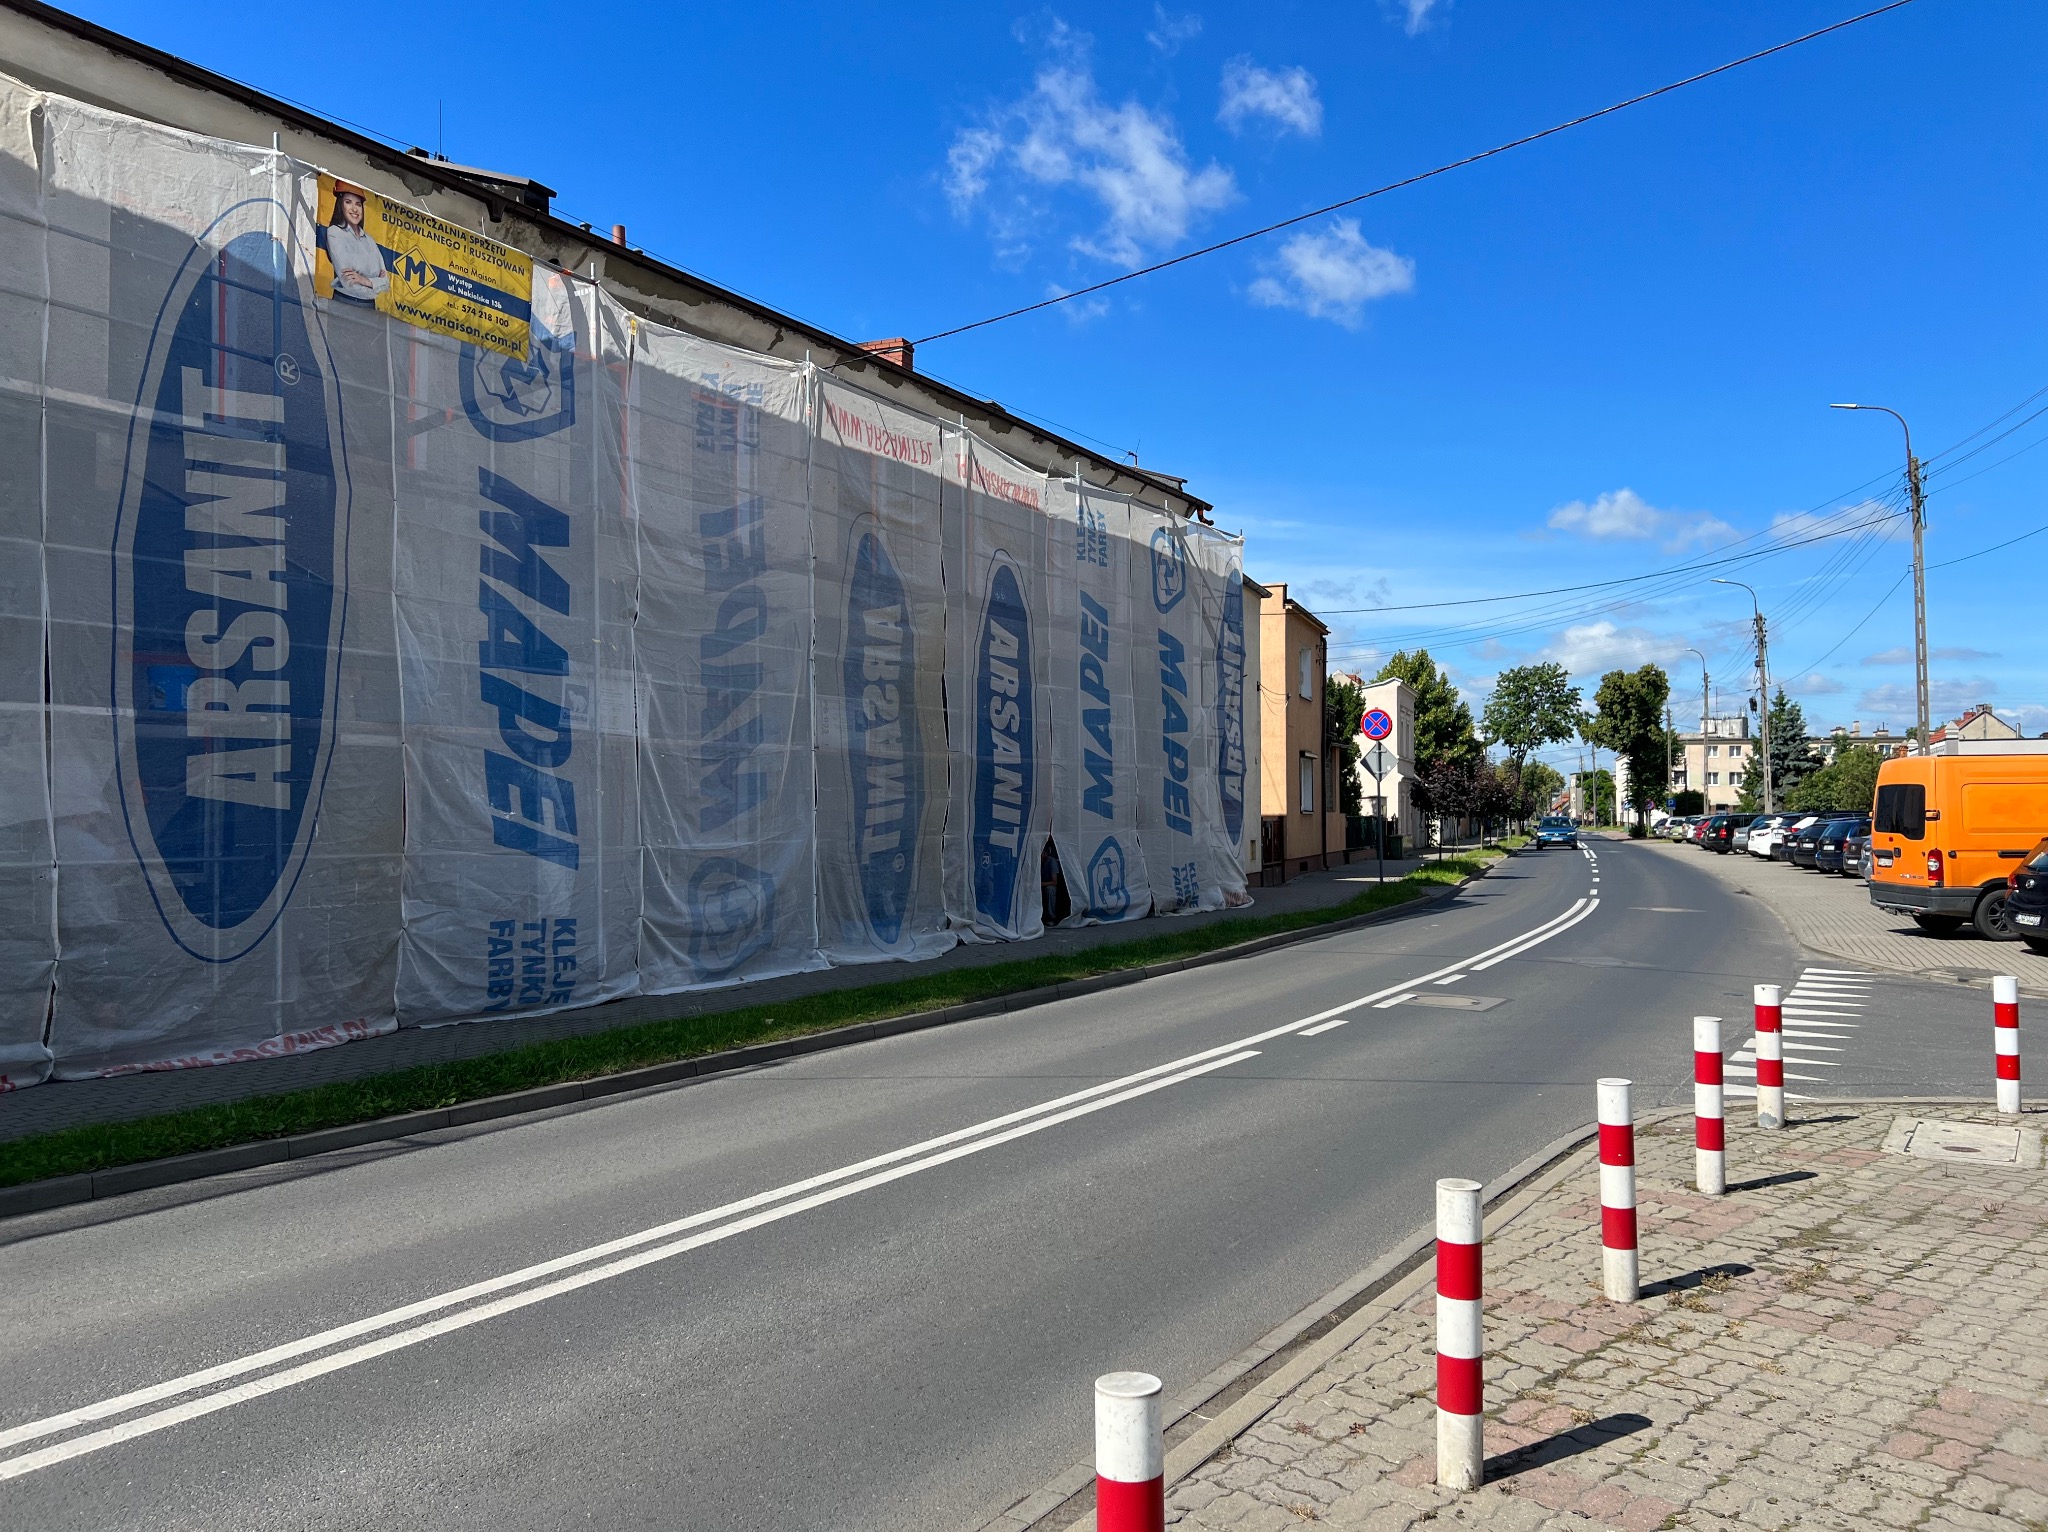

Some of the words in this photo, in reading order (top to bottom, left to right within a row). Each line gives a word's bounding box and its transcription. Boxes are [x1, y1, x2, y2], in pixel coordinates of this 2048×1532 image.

[382, 200, 466, 241] WYPOŻYCZALNIA
[469, 235, 507, 256] SPRZĘTU
[382, 213, 461, 250] BUDOWLANEGO
[463, 245, 467, 253] I
[469, 247, 525, 276] RUSZTOWAŃ
[403, 256, 426, 287] M
[447, 284, 457, 293] ul.
[457, 287, 490, 305] Nakielska
[448, 274, 473, 289] Występ
[449, 260, 469, 274] Anna
[470, 268, 497, 285] Maison
[395, 301, 522, 352] www.maison.com.pl
[461, 304, 477, 316] 574
[478, 310, 493, 322] 218
[495, 316, 509, 328] 100
[1097, 509, 1108, 568] FARBY
[181, 365, 291, 810] ARSANIT
[478, 465, 579, 871] MAPEI
[1079, 589, 1114, 820] MAPEI
[1157, 627, 1193, 837] MAPEI
[1221, 617, 1243, 804] ARSANIT
[989, 618, 1023, 858] ARSANIT
[544, 918, 577, 1004] KLEJE
